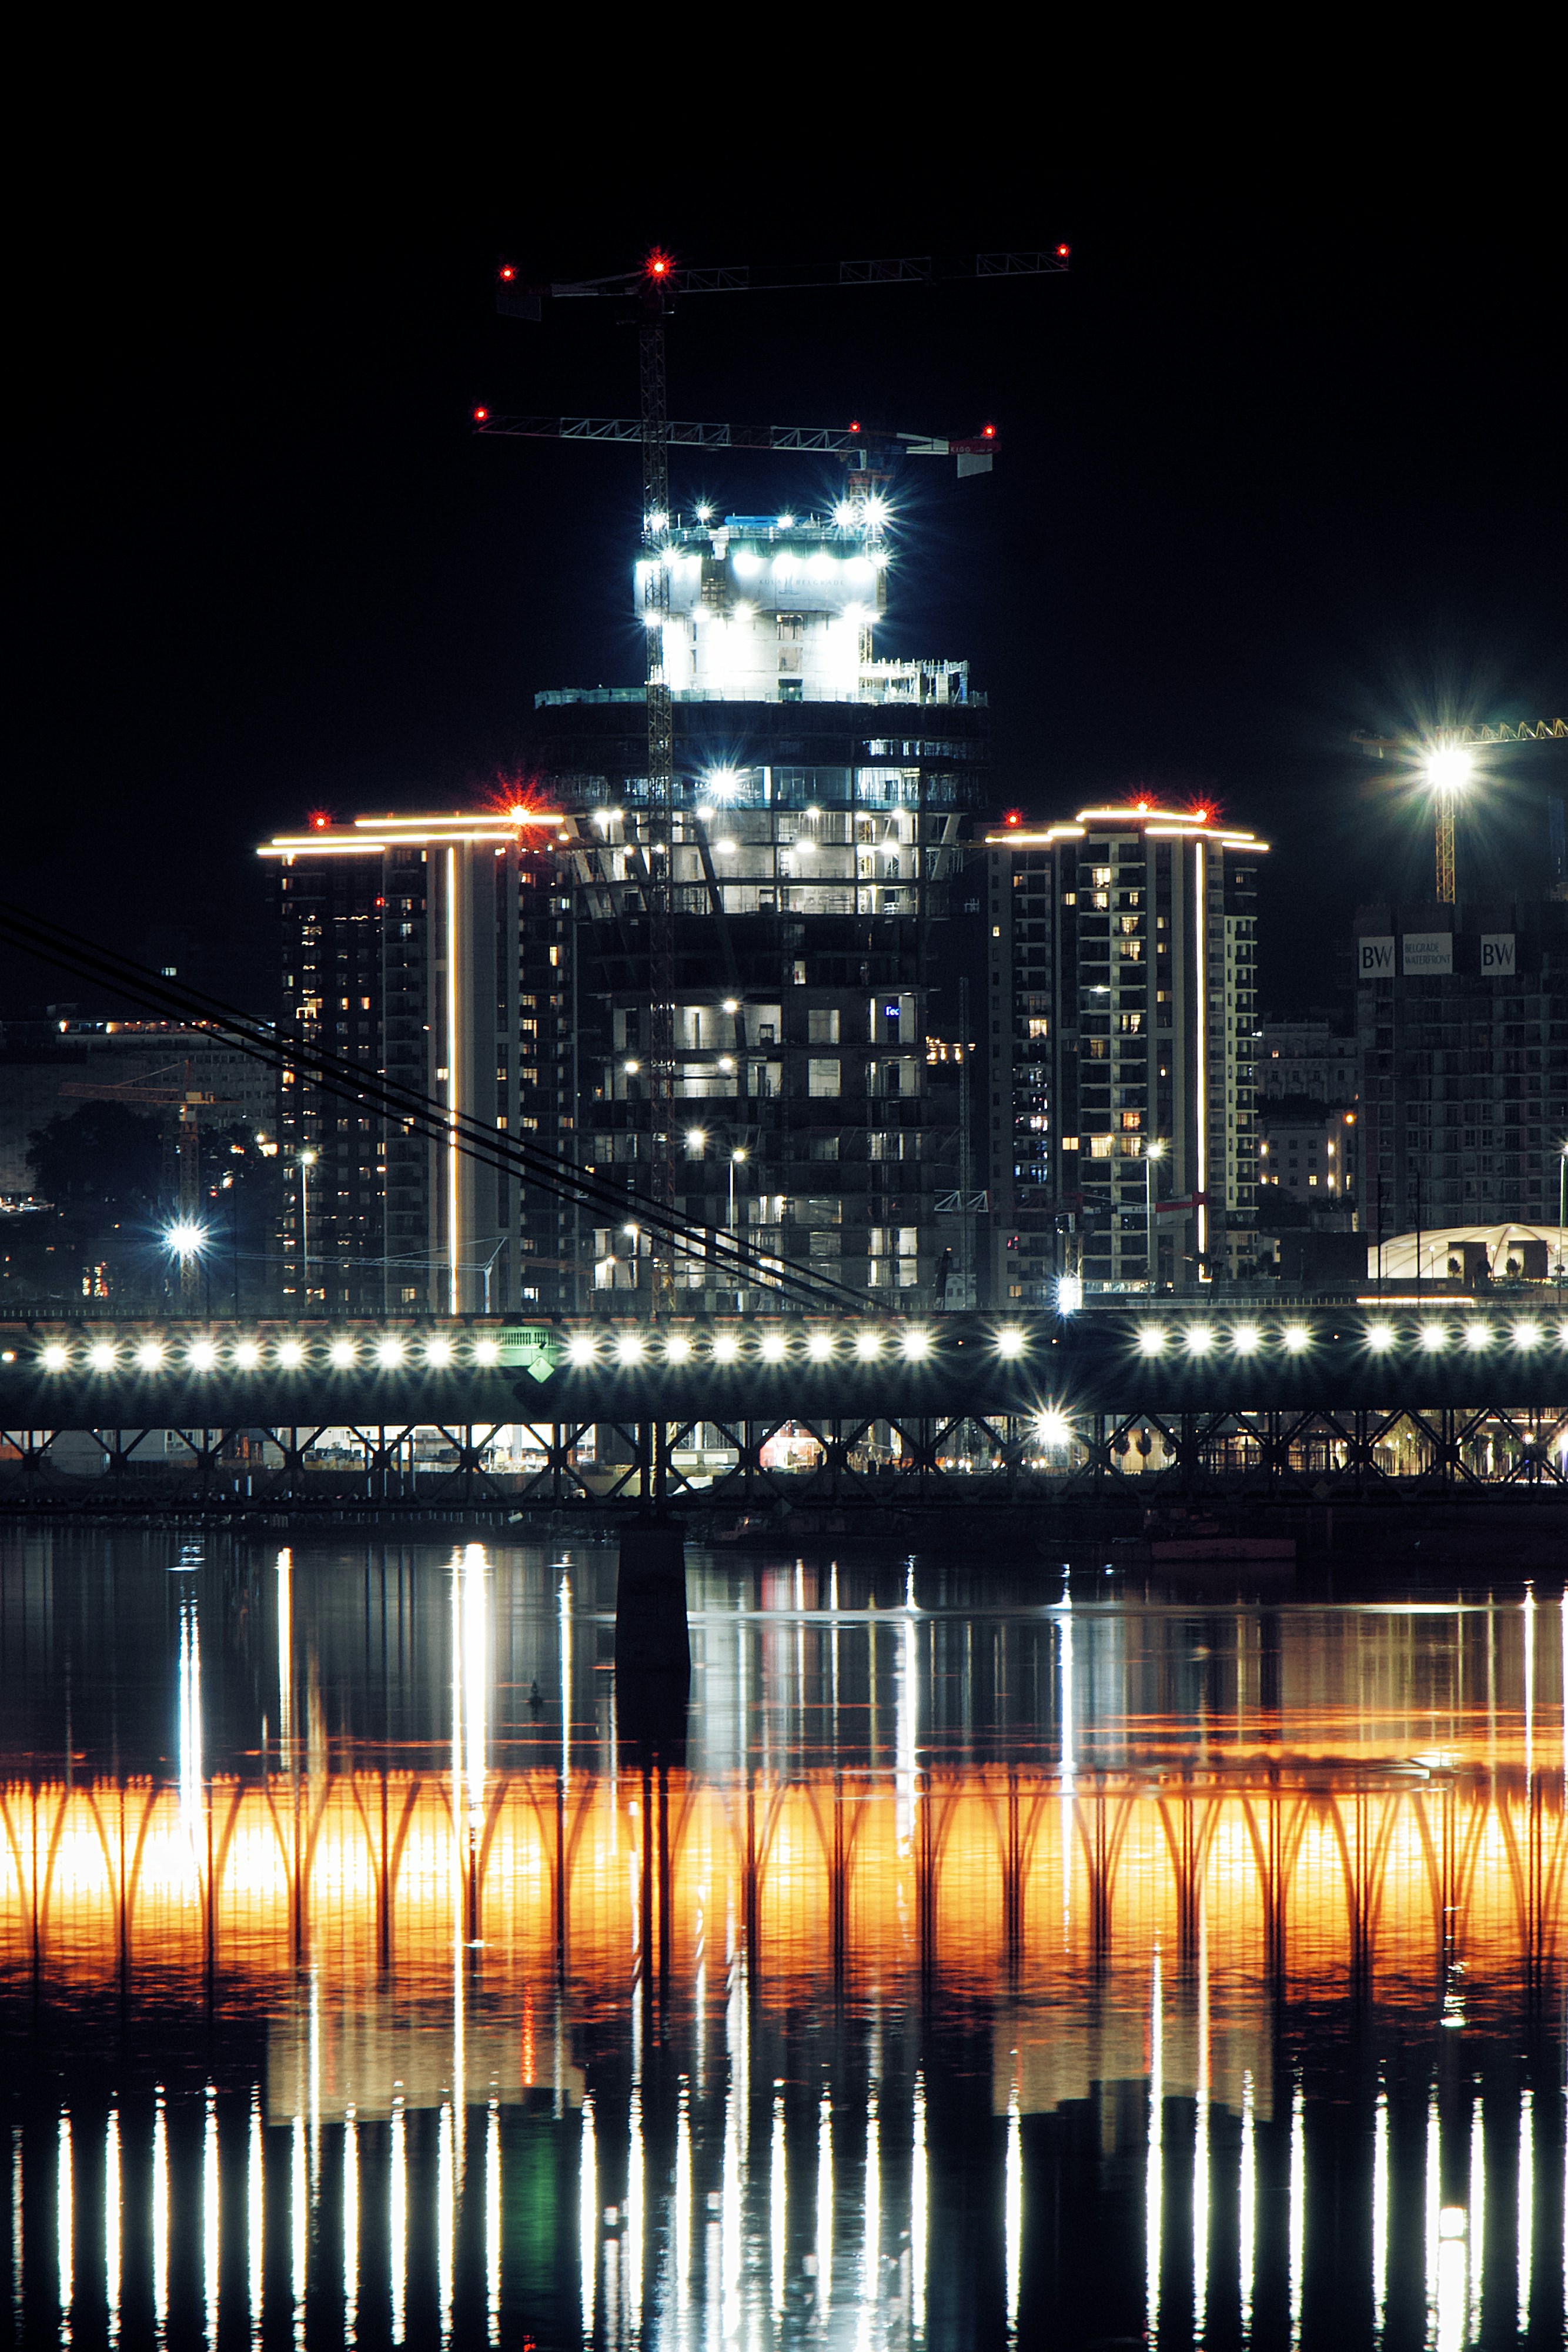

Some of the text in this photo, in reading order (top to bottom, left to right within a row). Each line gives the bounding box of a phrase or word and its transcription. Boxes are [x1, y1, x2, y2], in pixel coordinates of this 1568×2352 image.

[1405, 942, 1439, 953] BELGRADE
[1483, 944, 1514, 966] BW
[1363, 946, 1392, 968] BW
[1405, 954, 1450, 965] WATERFRONT
